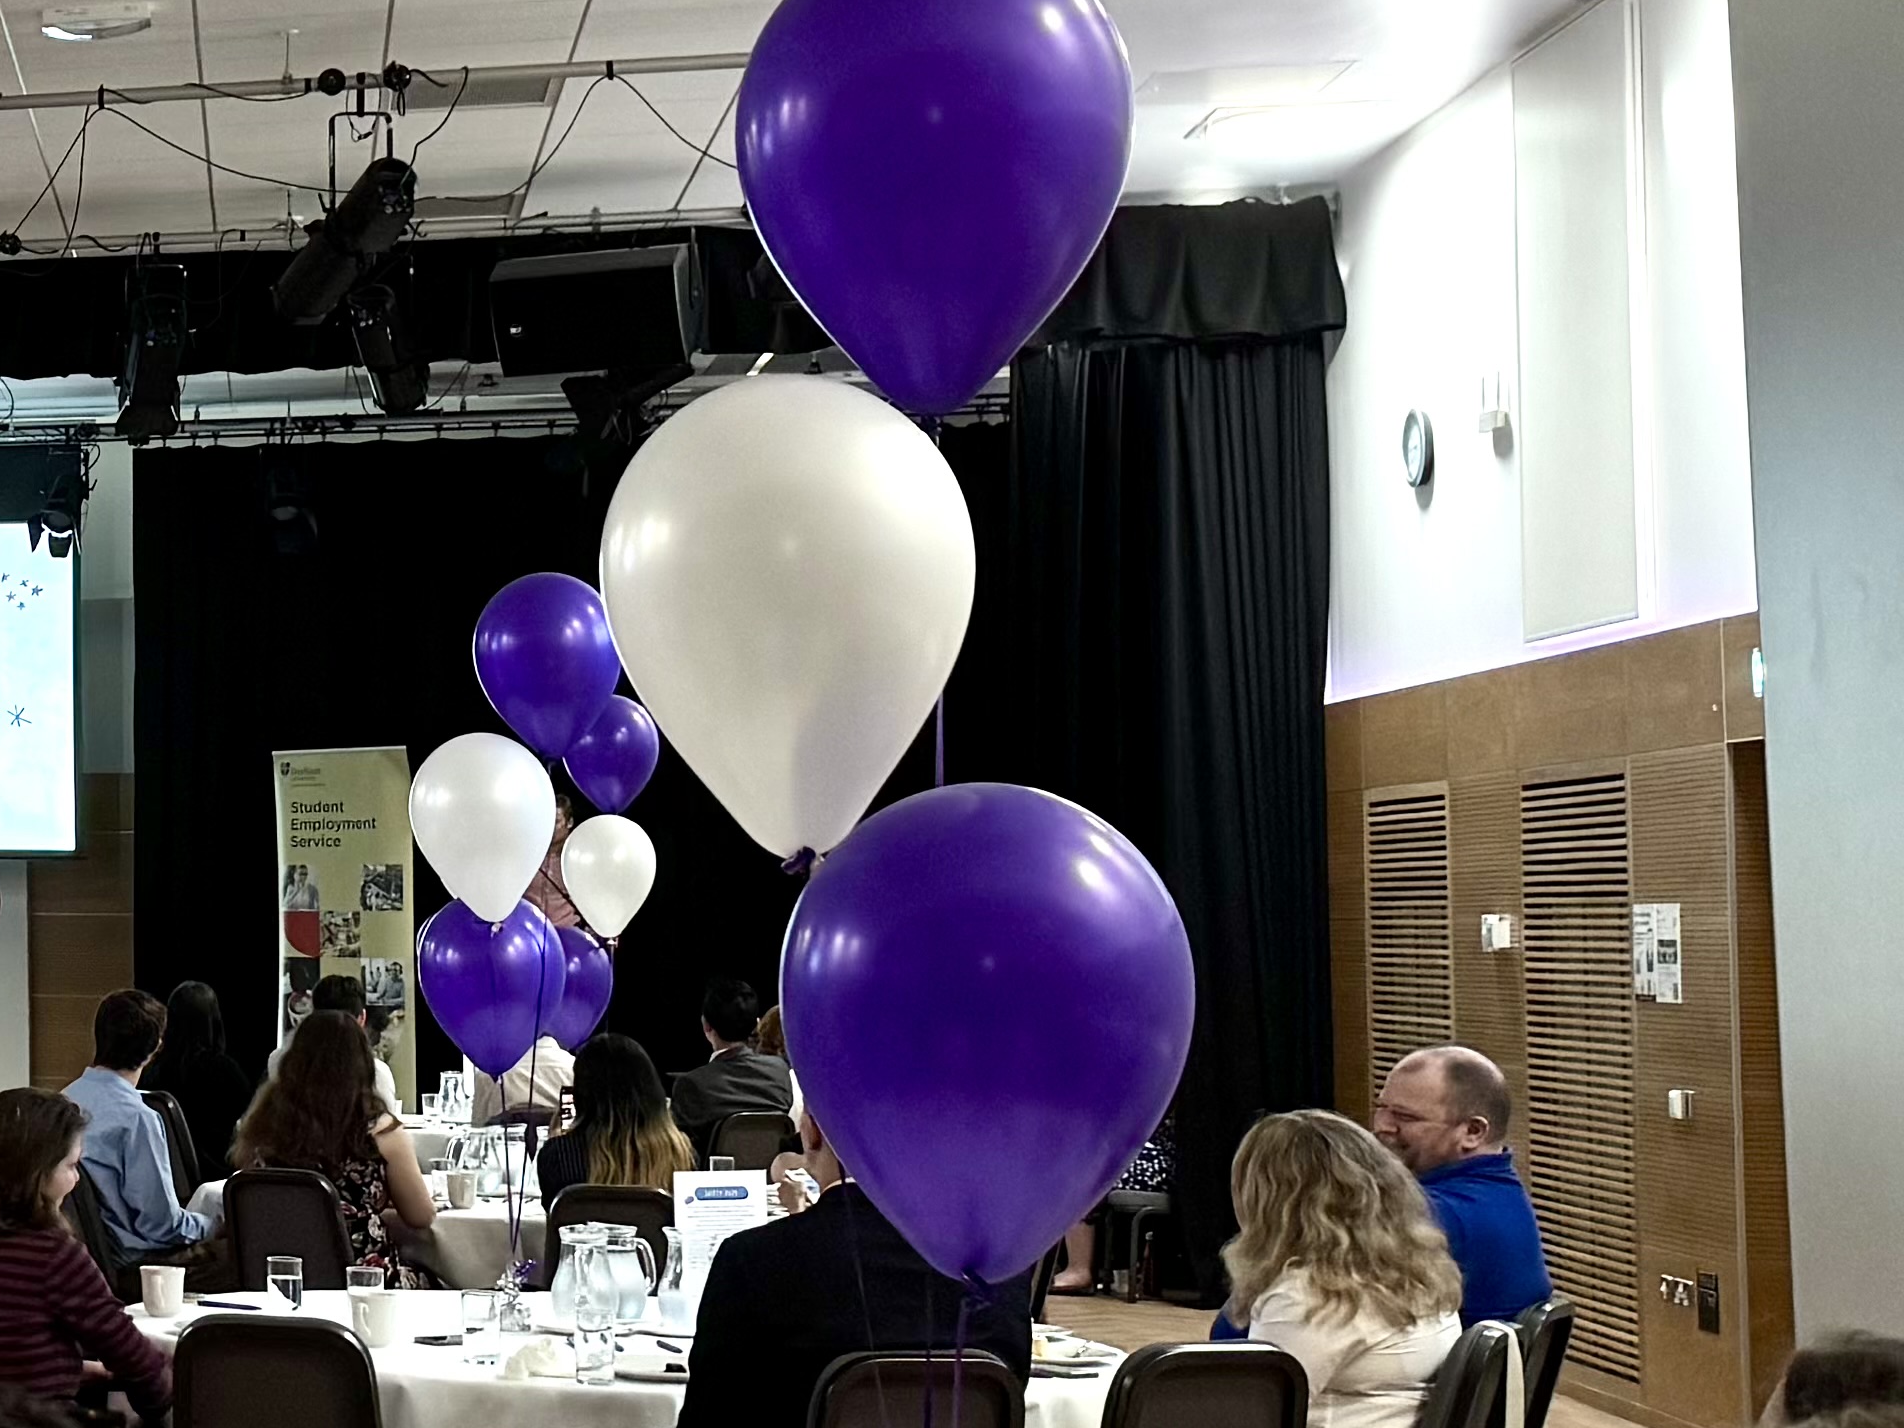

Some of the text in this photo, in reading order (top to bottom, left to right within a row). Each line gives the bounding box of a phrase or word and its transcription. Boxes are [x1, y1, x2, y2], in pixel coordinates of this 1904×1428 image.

[290, 801, 344, 814] Student
[290, 817, 377, 832] Employment
[290, 834, 342, 848] Service
